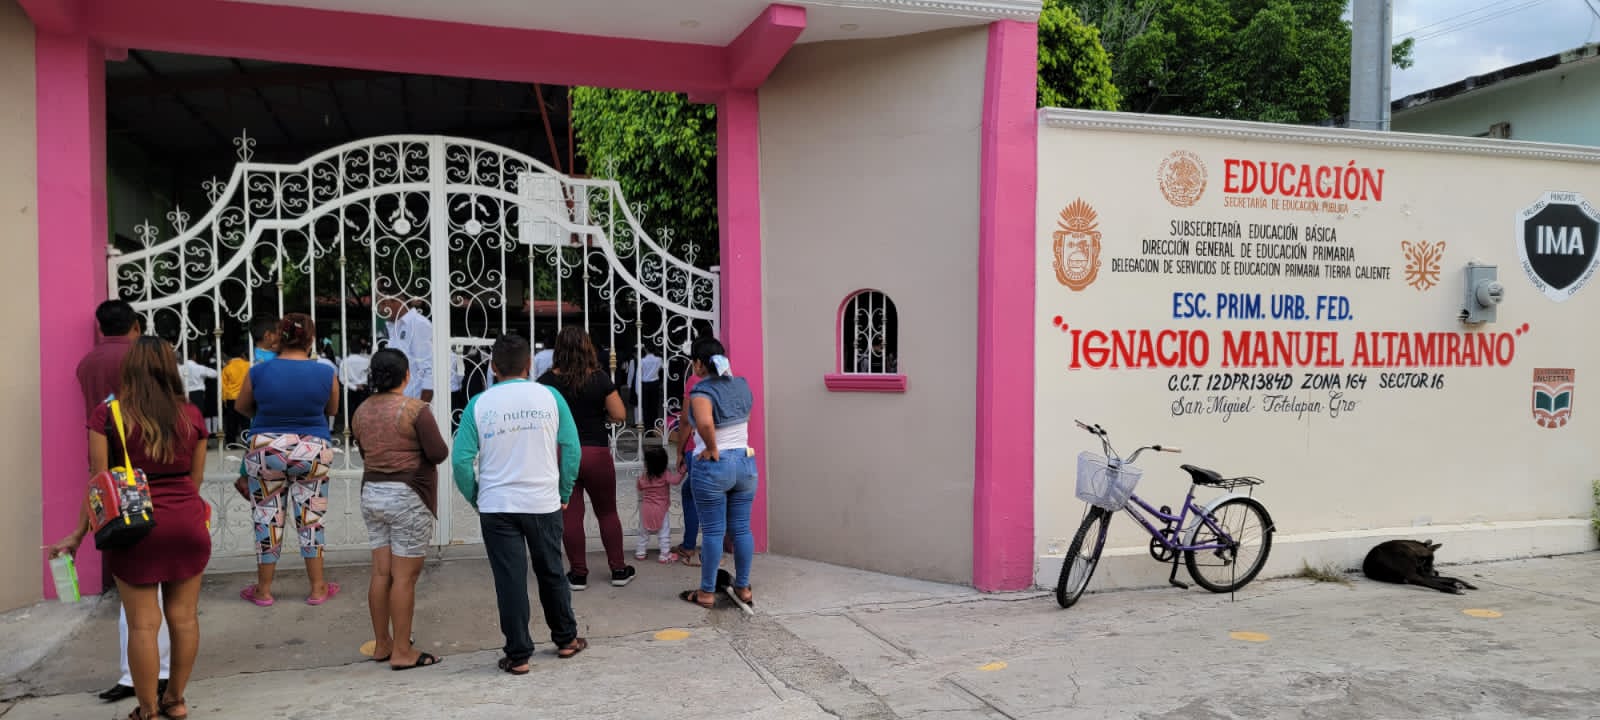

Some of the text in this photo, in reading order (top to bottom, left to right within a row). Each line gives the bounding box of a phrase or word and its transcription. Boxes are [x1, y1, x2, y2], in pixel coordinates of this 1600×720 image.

[1224, 159, 1384, 201] EDUCACIÓN
[1271, 198, 1280, 210] DE
[1169, 219, 1337, 242] SUBSECRETARÍA EDUCACIÓN BÁSICA
[1537, 225, 1585, 256] IMA
[1142, 237, 1355, 262] DIRECCIÓN GENERAL DE EDUCACIÓN PRIMARIA
[1163, 260, 1174, 275] DE
[1176, 260, 1217, 275] SERVICIOS
[1221, 261, 1231, 276] DE
[1285, 263, 1320, 278] PRIMARIA
[1324, 264, 1351, 279] TIERRA
[1355, 265, 1391, 281] CALIENTE
[1172, 292, 1353, 321] ESC. PRIM. URB. FED.
[1220, 330, 1345, 369] MANUEL
[1168, 373, 1445, 392] C.C.T. 12DPR1384D ZONA 164 SECTOR 16
[503, 407, 551, 422] nutresa
